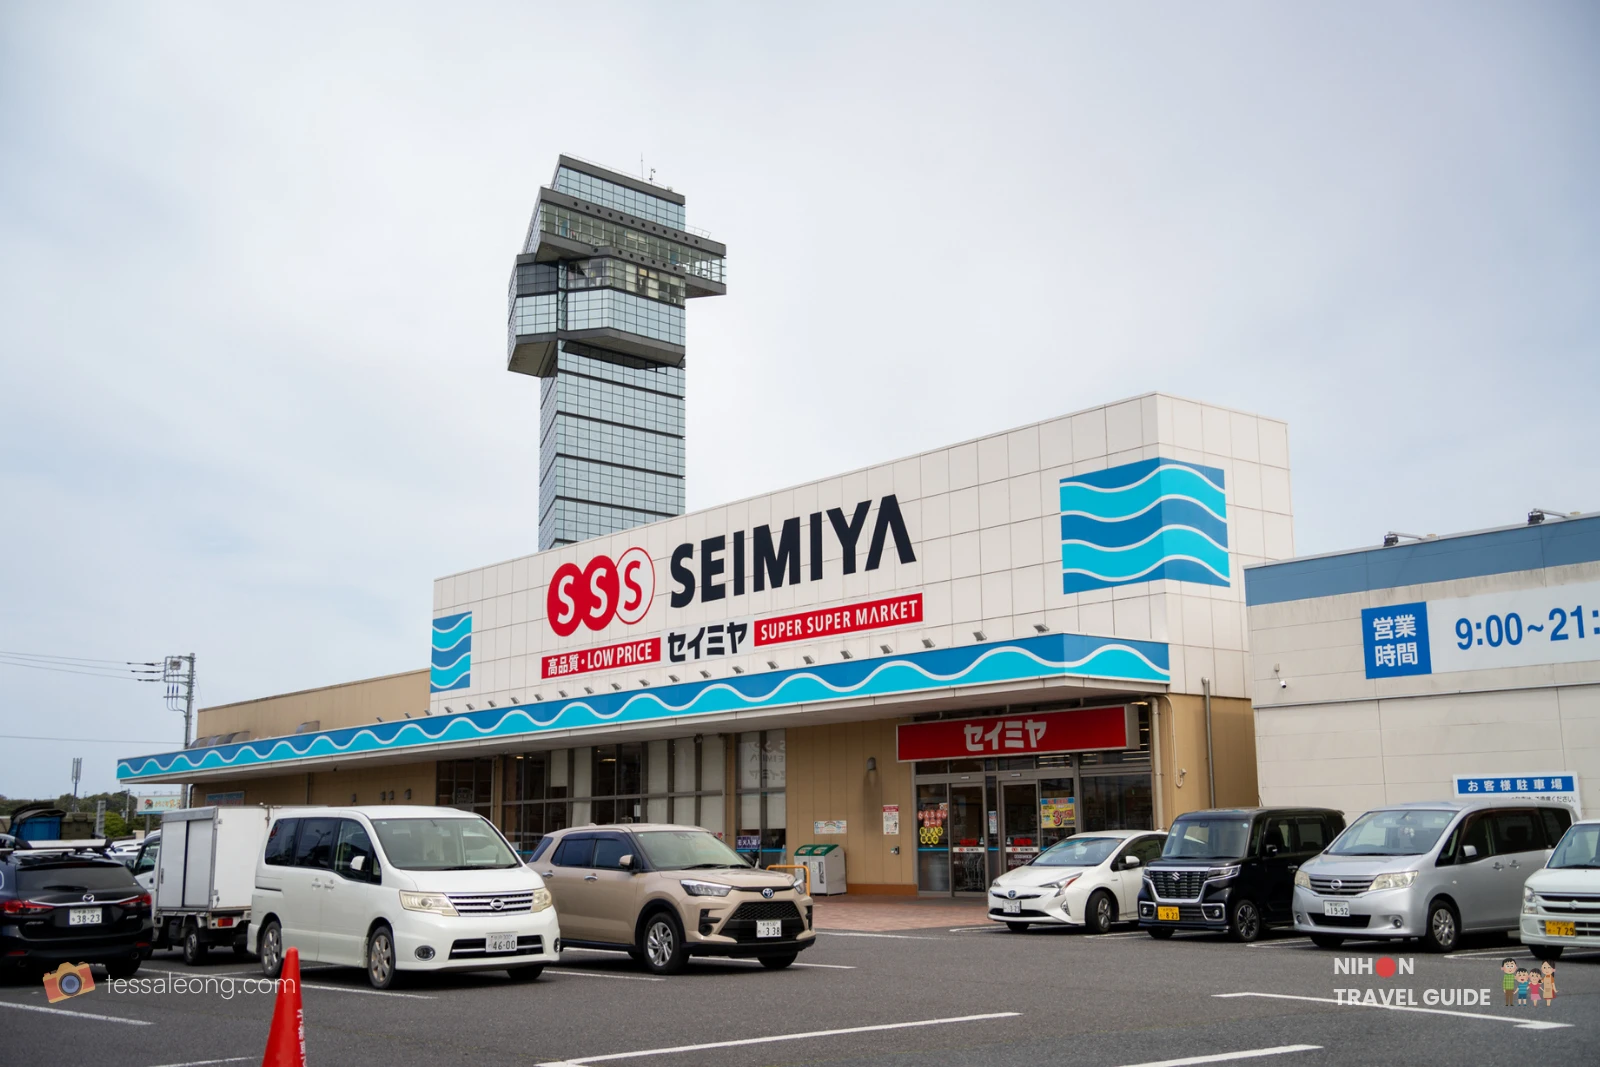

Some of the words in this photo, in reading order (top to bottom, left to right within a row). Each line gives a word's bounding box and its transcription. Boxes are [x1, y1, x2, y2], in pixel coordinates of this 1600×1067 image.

[670, 493, 917, 608] SEIMIYA
[760, 619, 802, 641] SUPER
[807, 612, 852, 634] SUPER
[855, 599, 918, 626] MARKET
[1373, 614, 1417, 641] 営業
[617, 642, 652, 665] PRICE
[668, 621, 748, 663] セイミヤ
[1375, 642, 1418, 667] 時間
[963, 719, 1047, 751] セイミヤ
[1467, 778, 1563, 792] お客様駐車場
